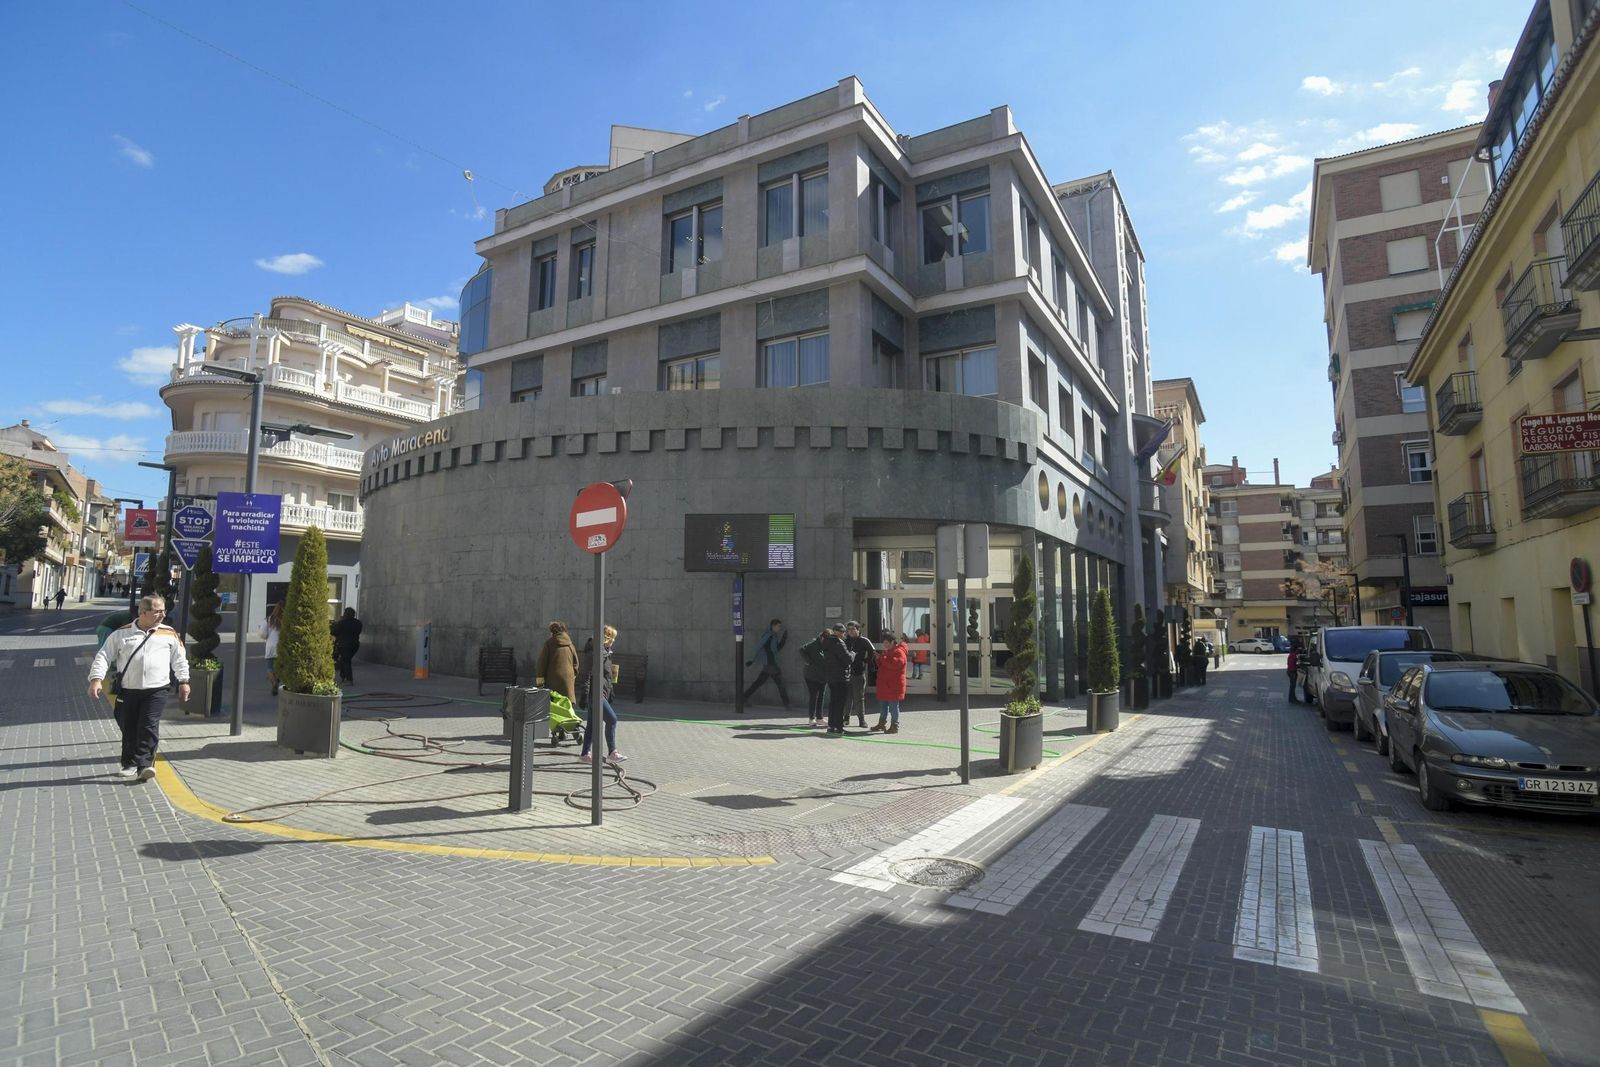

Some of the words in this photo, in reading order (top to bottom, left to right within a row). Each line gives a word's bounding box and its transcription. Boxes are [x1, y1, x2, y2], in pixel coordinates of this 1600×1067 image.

[1522, 417, 1543, 427] Angel
[1545, 416, 1556, 425] M.
[1557, 415, 1585, 424] Legaza
[1522, 424, 1583, 436] SEGUROS
[1523, 433, 1576, 444] ASESORIA
[1582, 431, 1600, 440] FIS
[371, 444, 389, 468] Ayto
[391, 428, 450, 457] Maracena
[1524, 442, 1563, 452] LABORAL
[222, 509, 240, 517] Para
[241, 511, 275, 519] erradicar
[178, 516, 210, 526] STOP
[236, 517, 270, 525] violencia
[234, 539, 260, 549] #ESTE
[216, 548, 276, 557] AYUNTAMIENTO
[217, 555, 230, 563] SE
[232, 555, 274, 564] IMPLICA
[1525, 779, 1541, 790] GR
[1545, 780, 1575, 792] 1213
[1578, 782, 1594, 793] AZ
